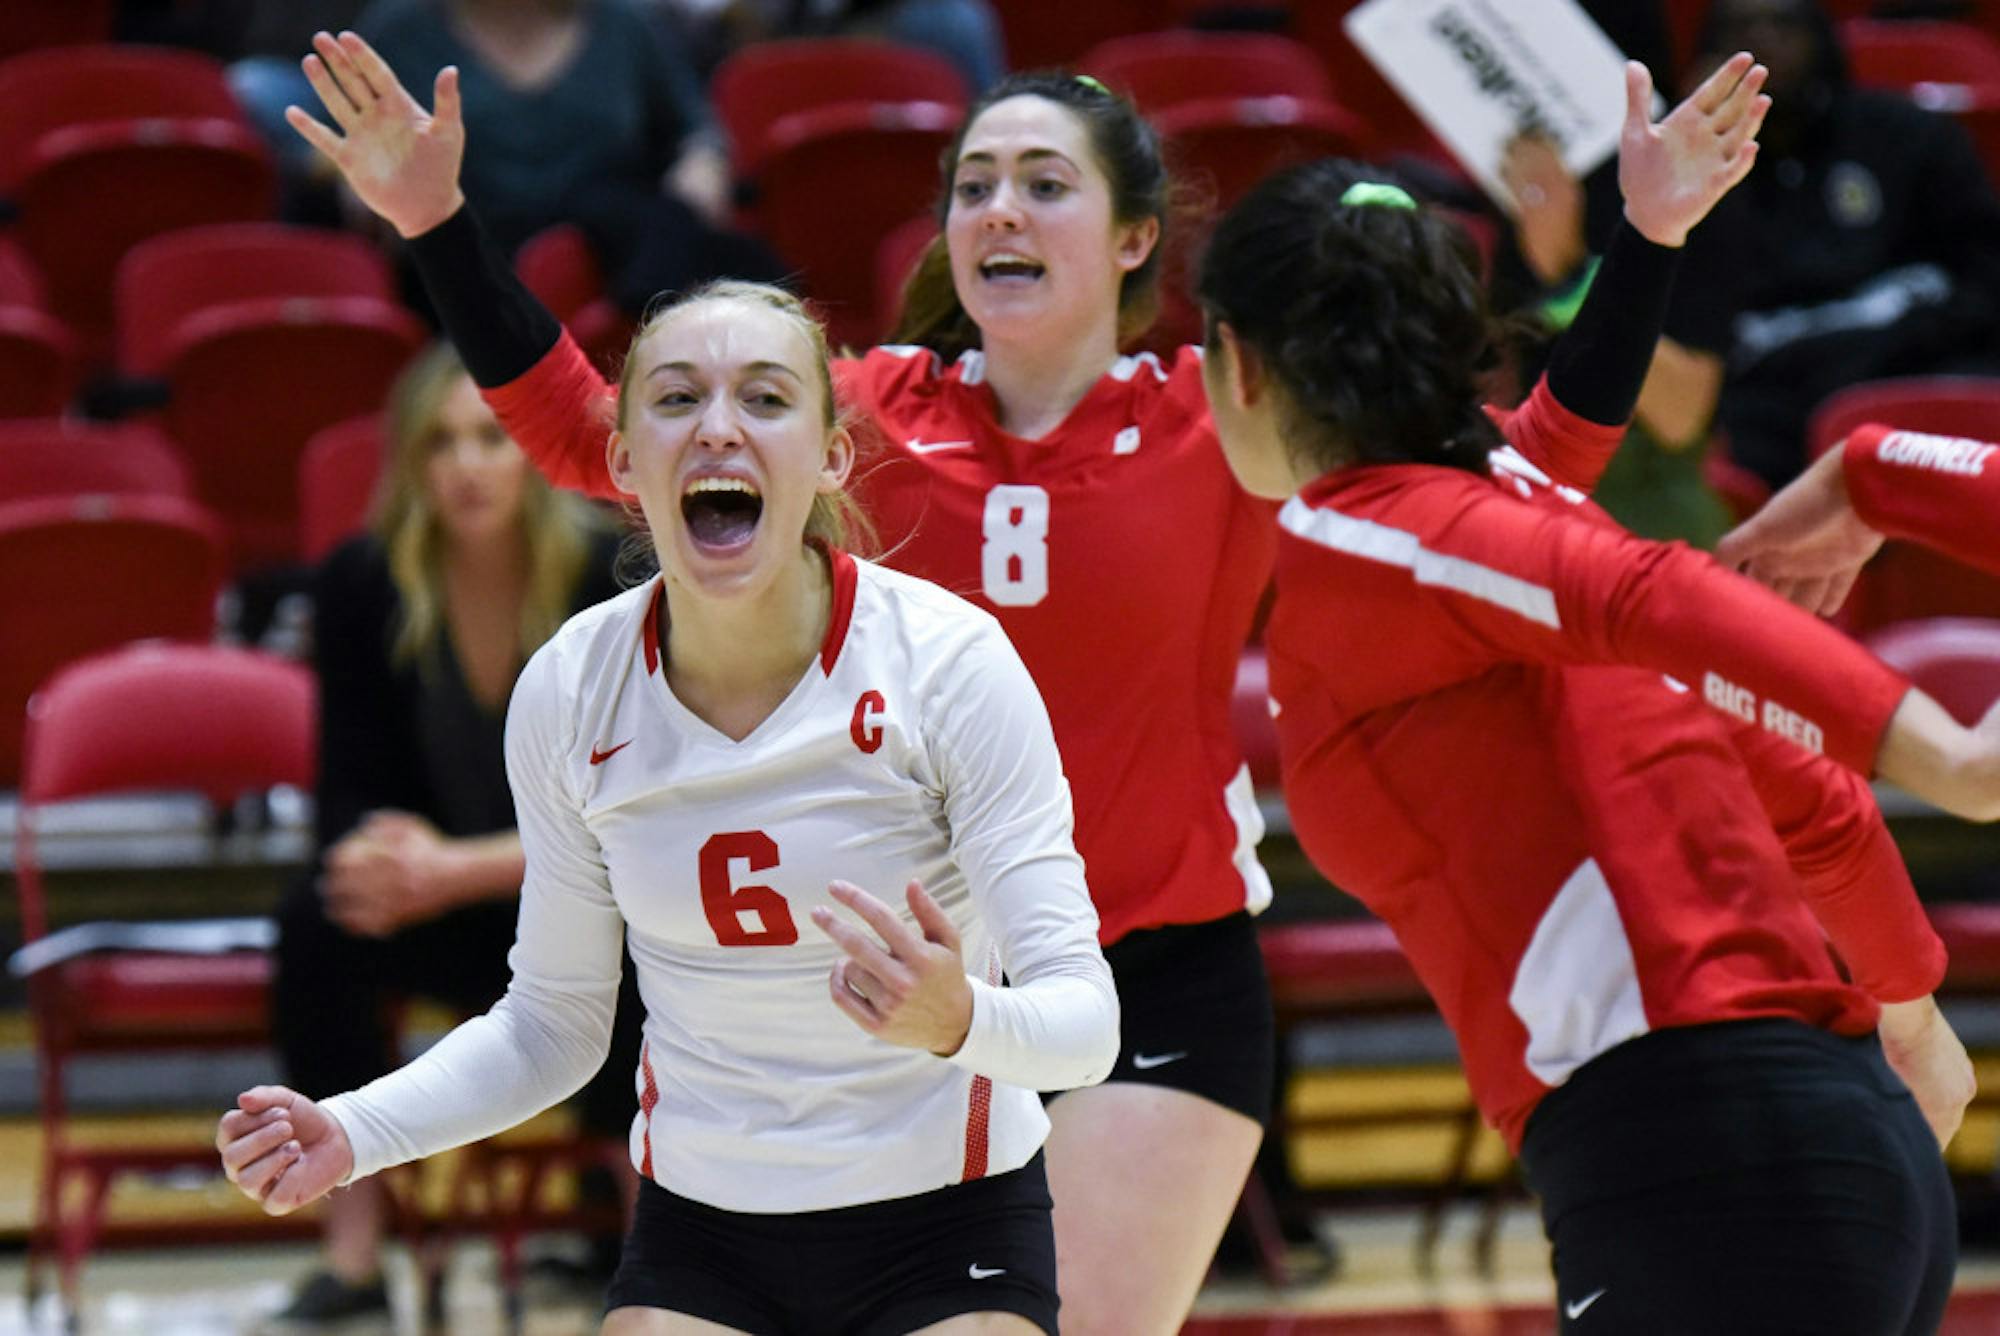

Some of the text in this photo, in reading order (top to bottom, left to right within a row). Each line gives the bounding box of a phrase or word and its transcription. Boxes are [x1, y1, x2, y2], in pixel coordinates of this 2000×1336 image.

[982, 483, 1049, 606] 8
[850, 689, 885, 754] C
[1704, 671, 1824, 755] BIG RED
[698, 830, 798, 947] 6
